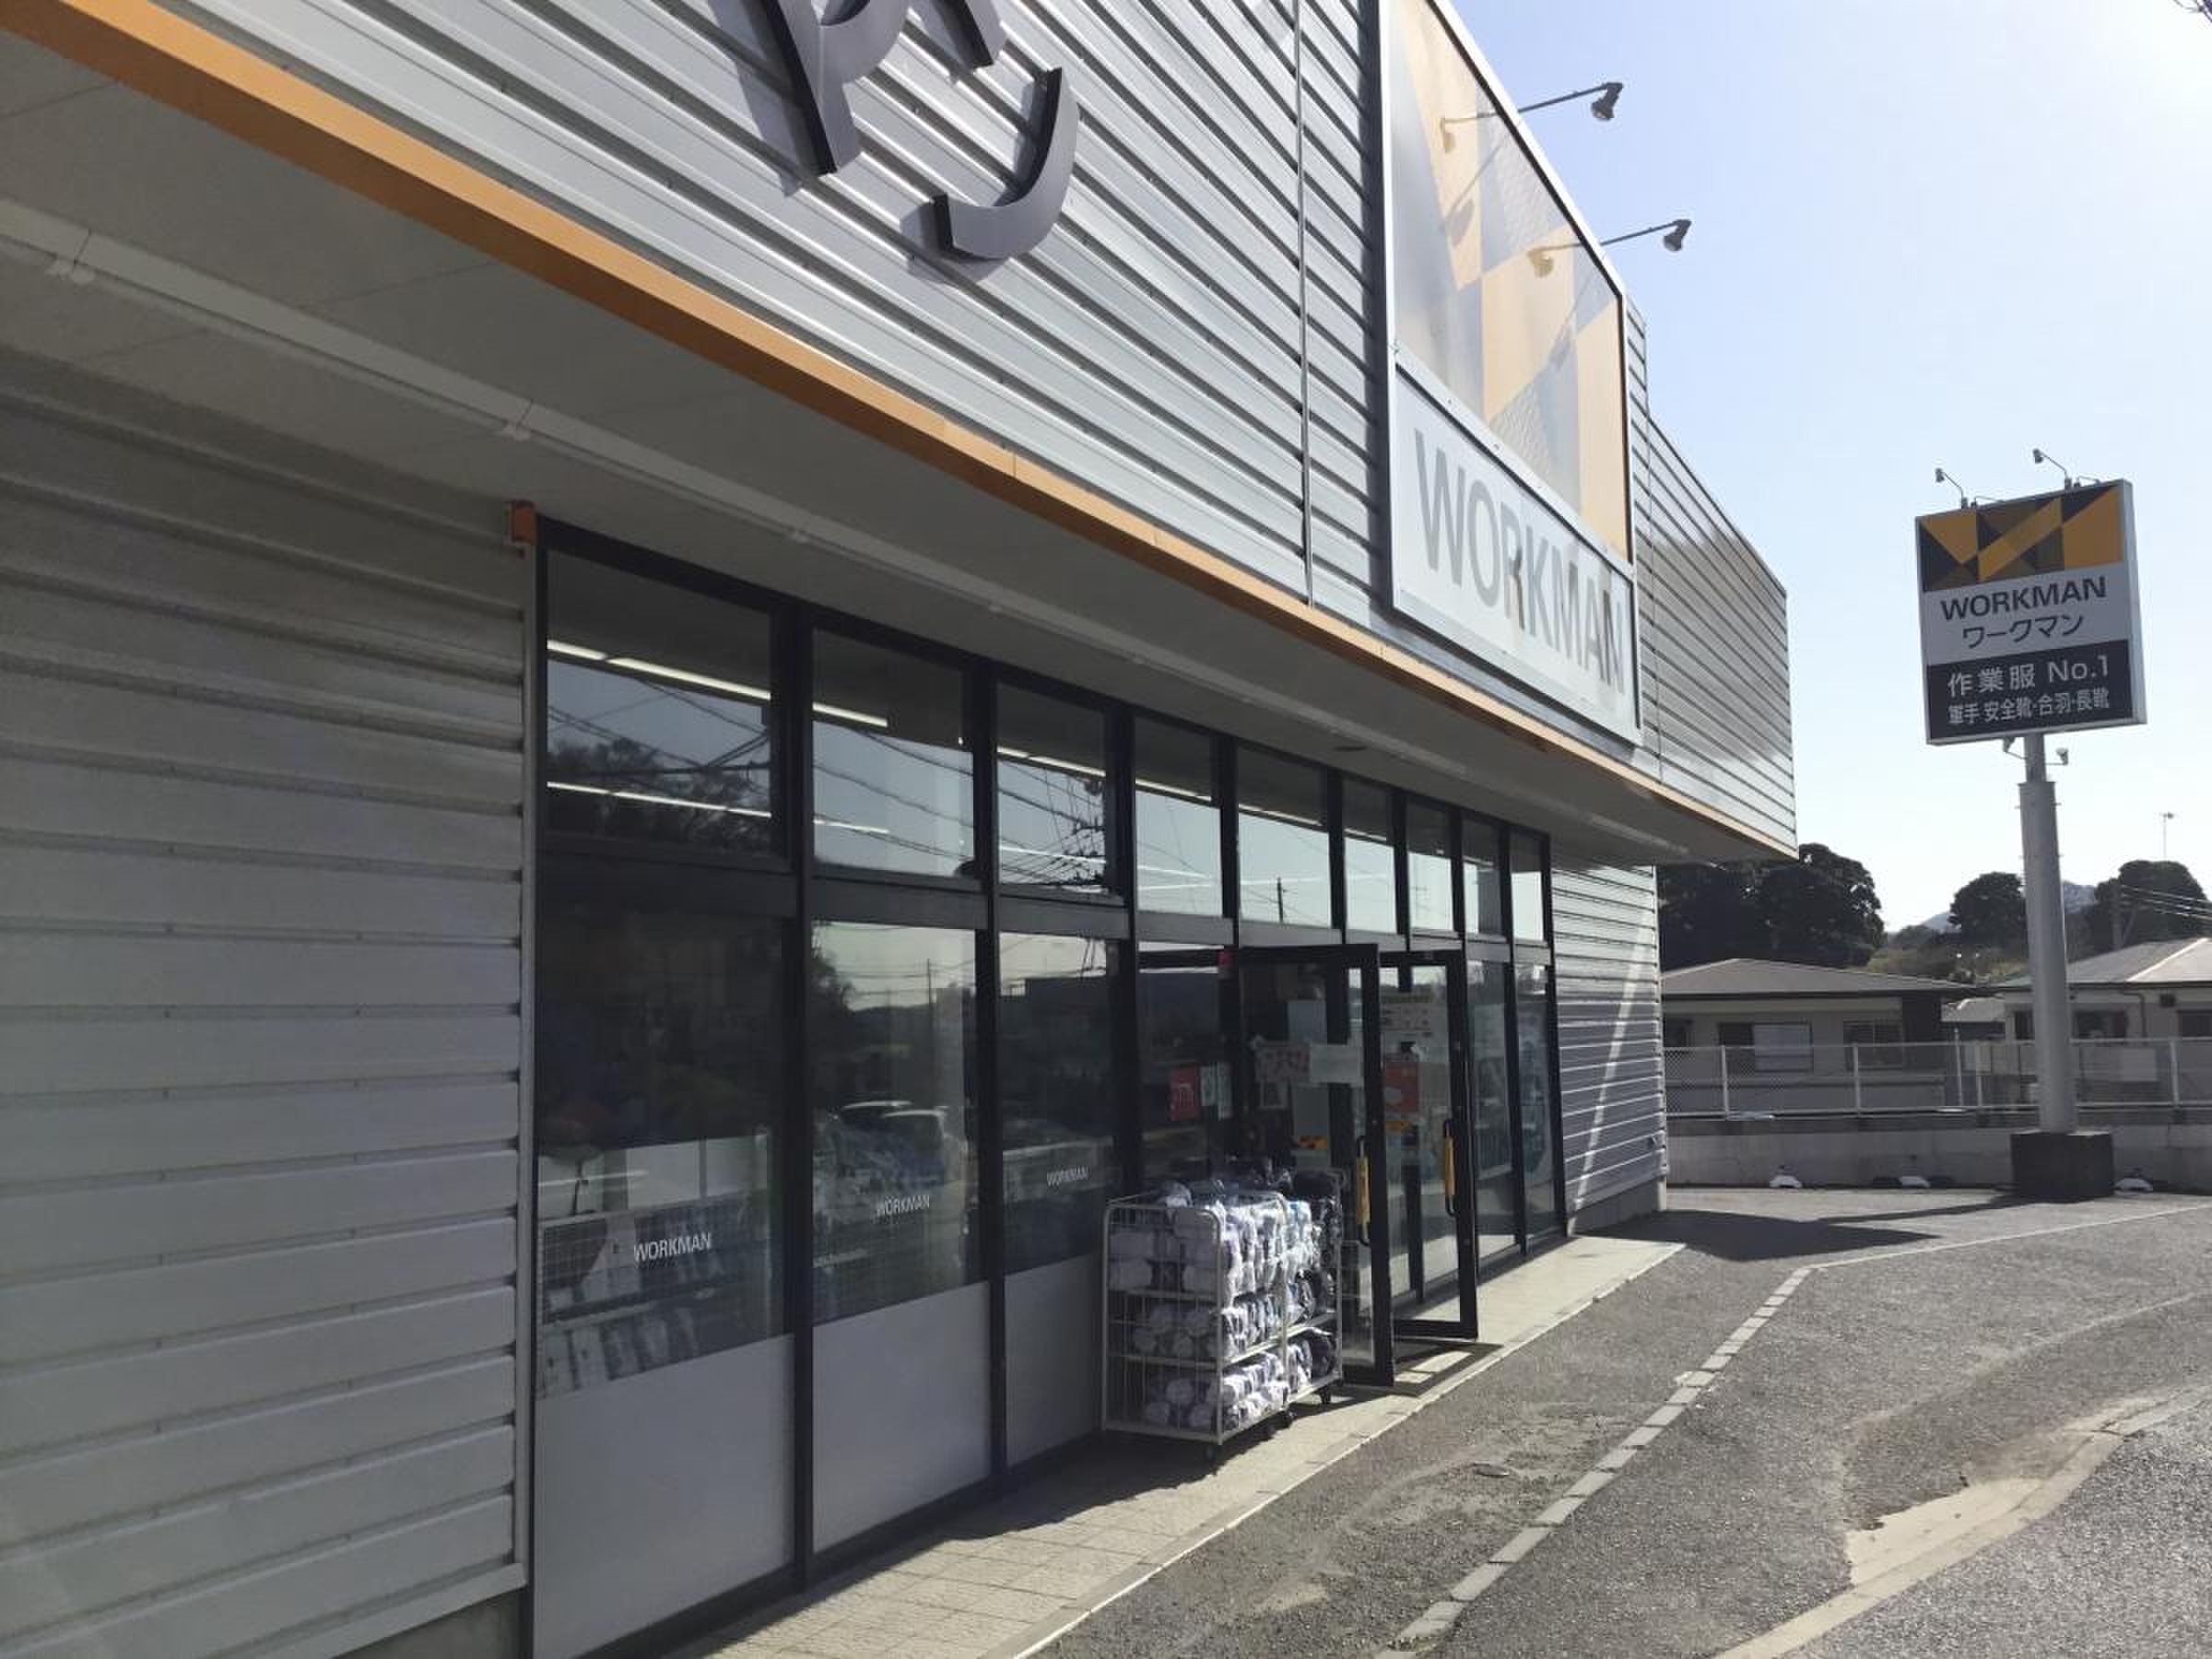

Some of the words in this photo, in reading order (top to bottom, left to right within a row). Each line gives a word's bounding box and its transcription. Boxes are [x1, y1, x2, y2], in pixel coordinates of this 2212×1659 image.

[1415, 427, 1625, 695] WORKMAN
[1940, 575, 2107, 621] WORKMAN
[1962, 614, 2084, 648] ワークマン
[1947, 663, 2036, 698] 作業服
[2048, 654, 2109, 683] No.1
[633, 1231, 712, 1263] WORKMAN
